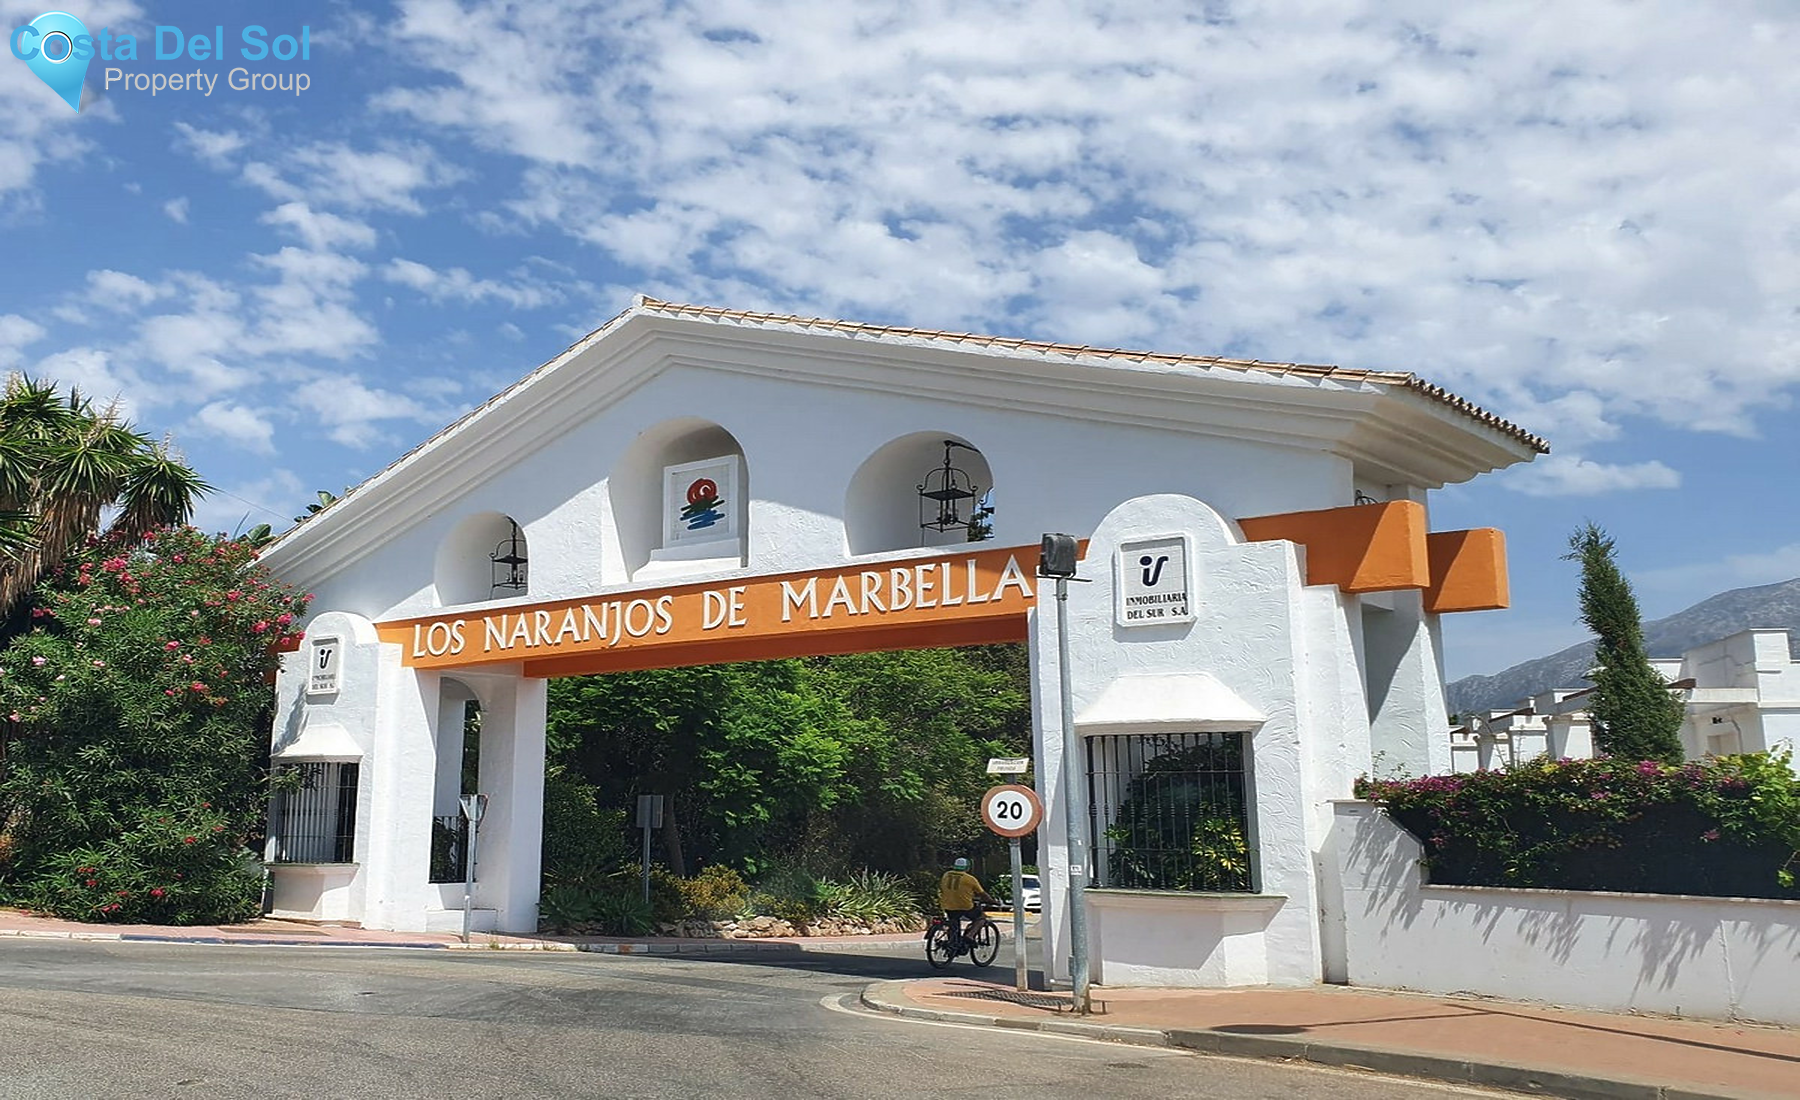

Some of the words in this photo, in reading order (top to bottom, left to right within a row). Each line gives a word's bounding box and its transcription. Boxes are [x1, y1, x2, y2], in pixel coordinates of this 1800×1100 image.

[412, 619, 466, 658] LOS
[482, 595, 673, 652] NARANJOS
[702, 586, 748, 630] DE
[780, 554, 1035, 622] MARBELLA
[1126, 592, 1188, 606] INMOBILIARIA
[1127, 609, 1144, 620] DEL
[1146, 608, 1164, 618] SUR
[997, 800, 1023, 820] 20
